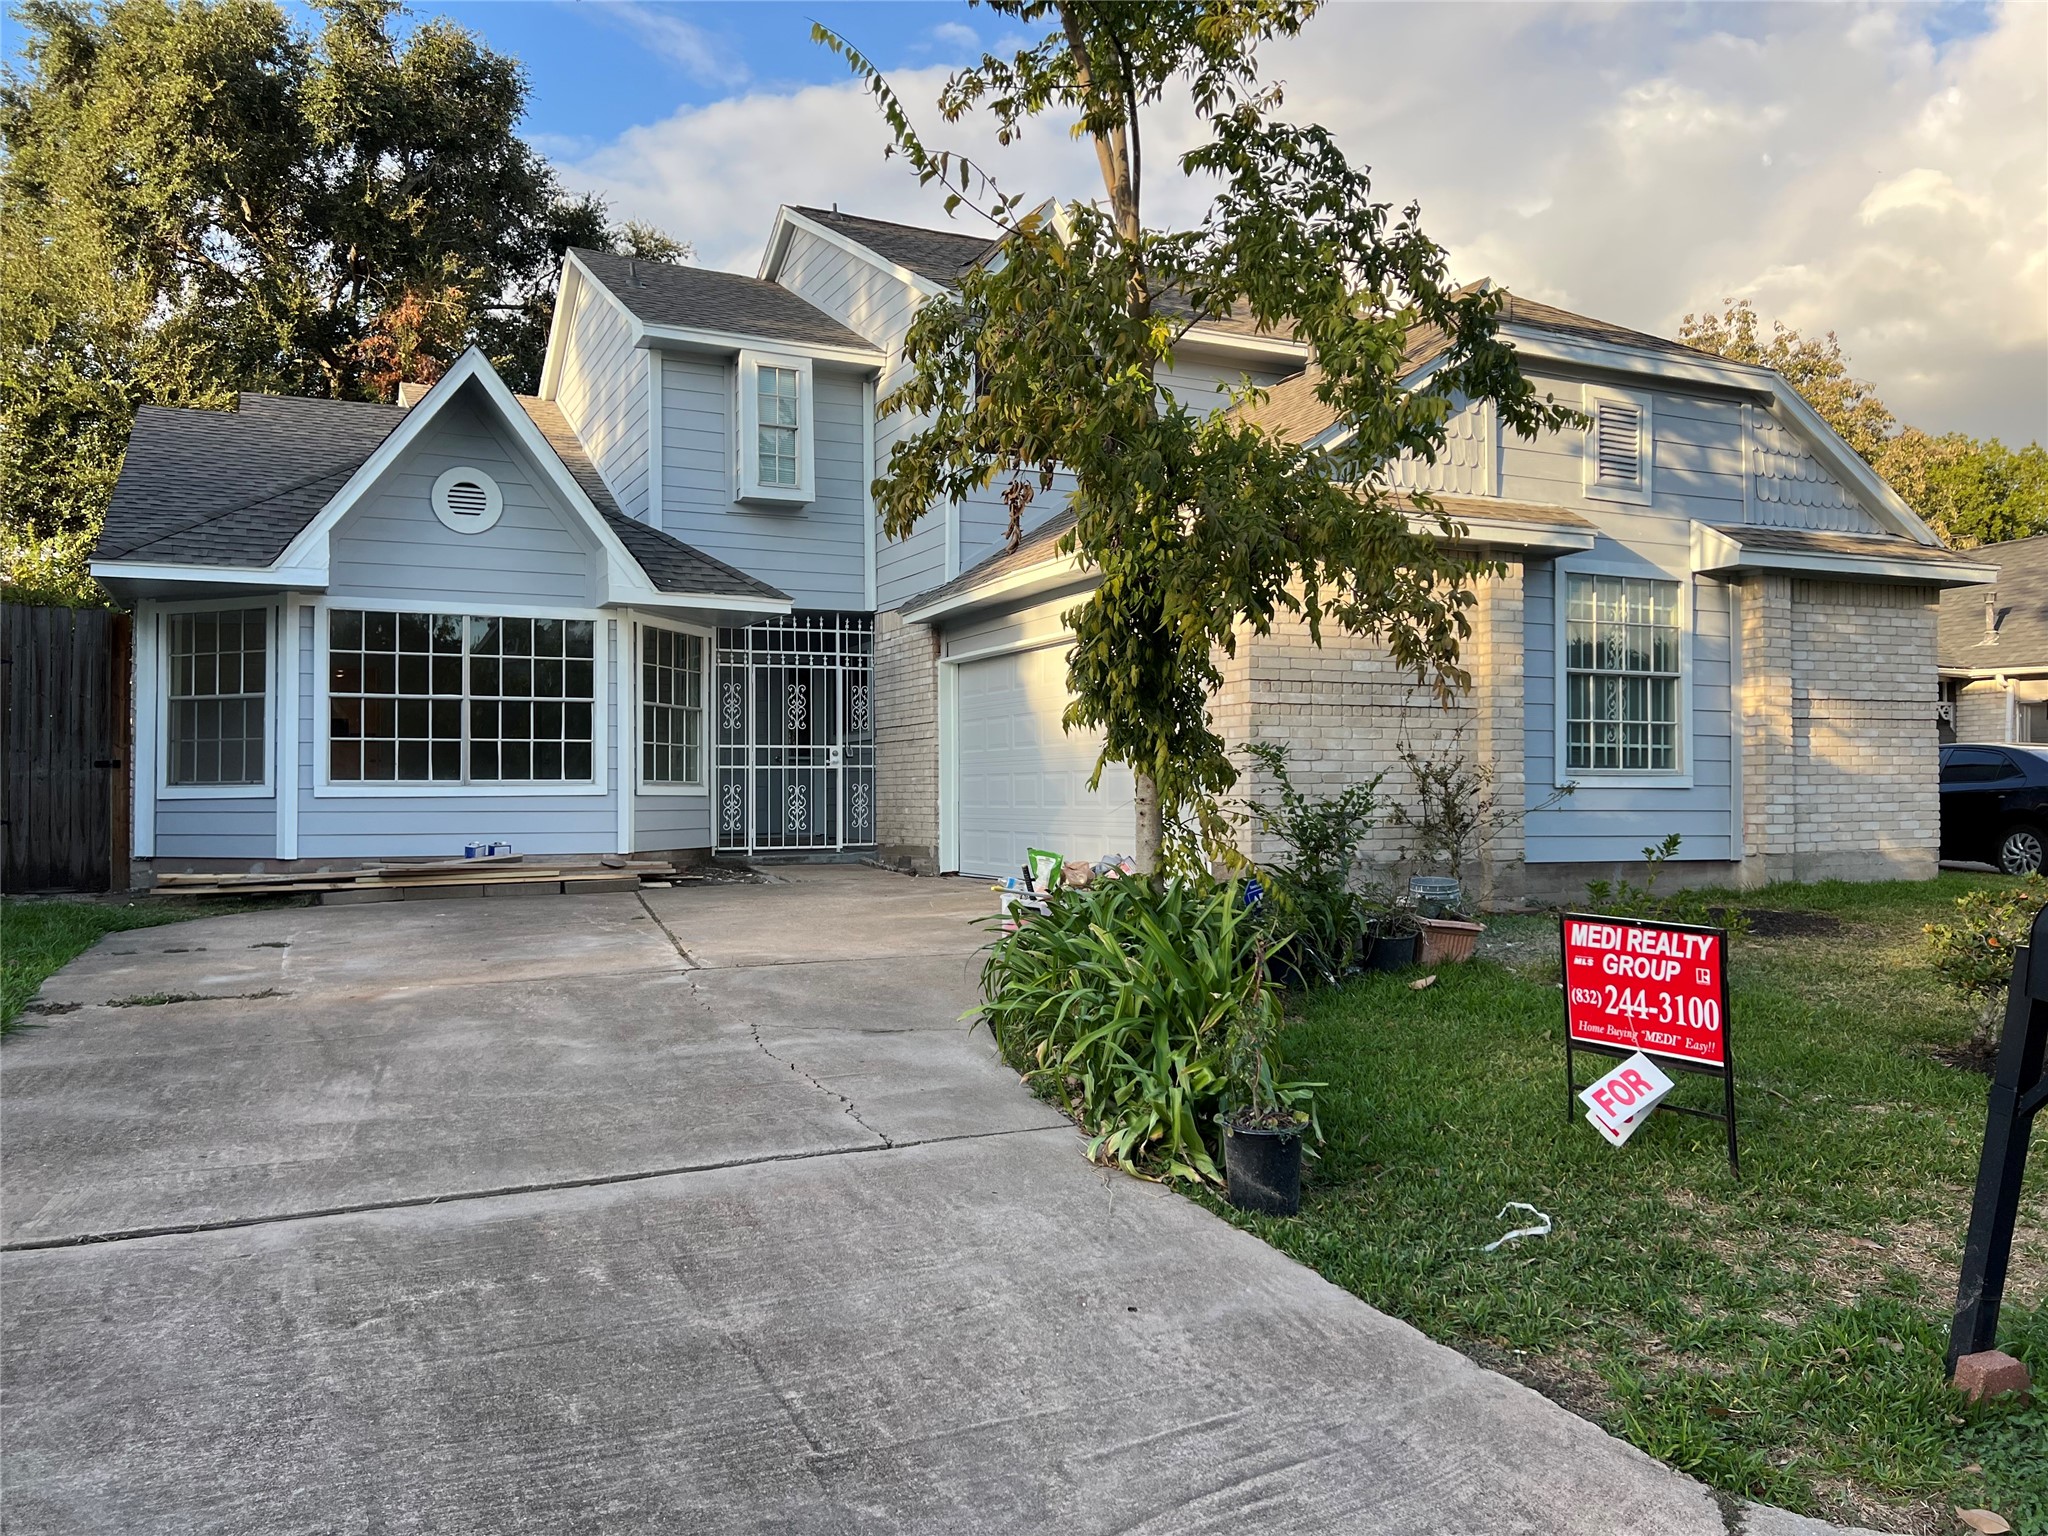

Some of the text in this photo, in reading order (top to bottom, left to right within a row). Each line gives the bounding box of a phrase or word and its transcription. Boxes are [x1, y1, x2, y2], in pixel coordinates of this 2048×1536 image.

[1571, 924, 1713, 961] MEDI REALTY
[1573, 957, 1594, 967] MLS
[1602, 953, 1681, 982] GROUP
[1571, 984, 1719, 1031] (832) 244-3100
[1578, 1020, 1605, 1034] Home
[1606, 1025, 1638, 1042] Buying
[1685, 1037, 1716, 1054] Easy!!
[1591, 1068, 1654, 1118] FOR
